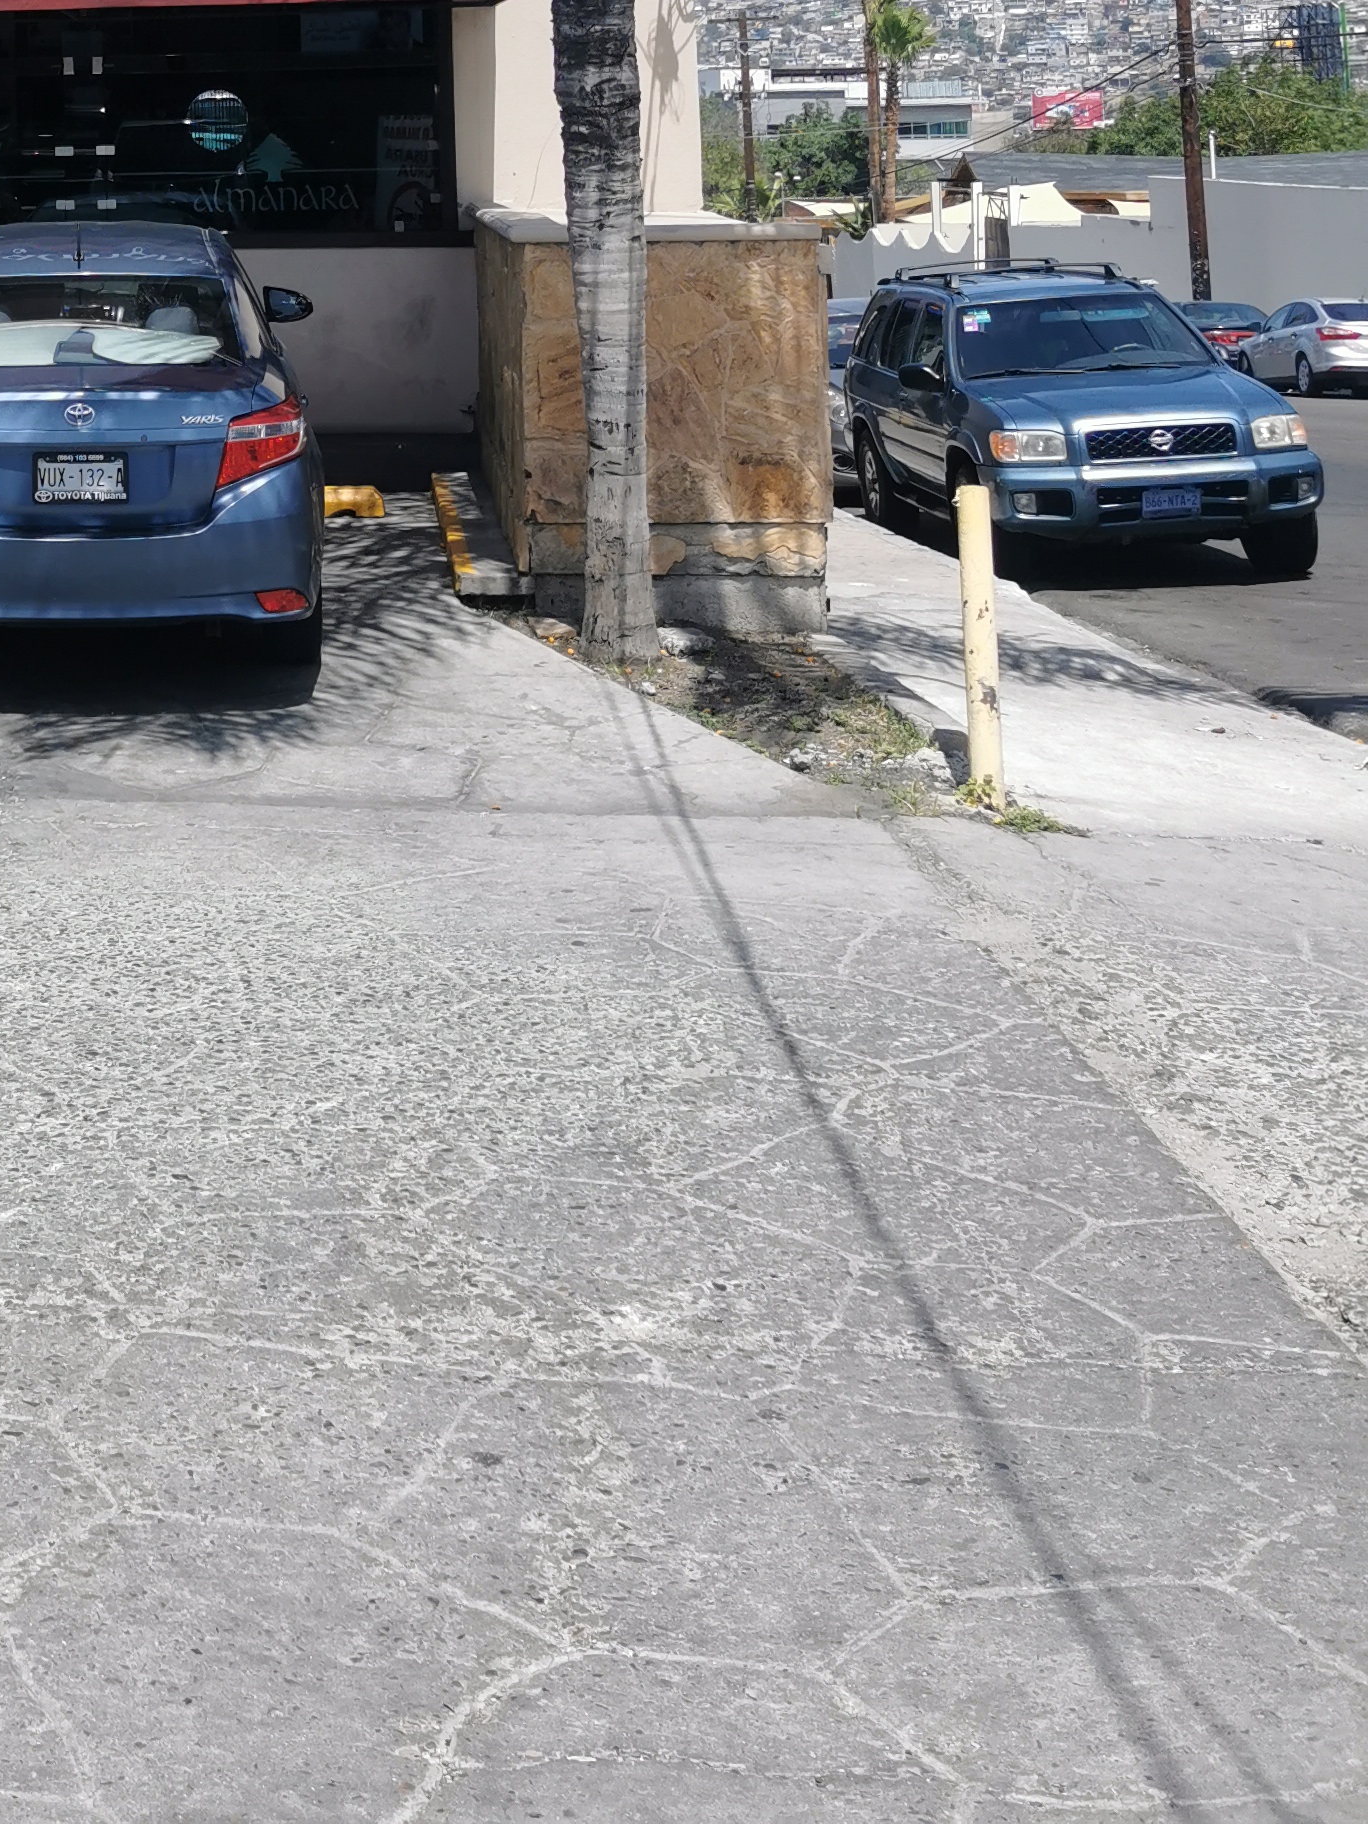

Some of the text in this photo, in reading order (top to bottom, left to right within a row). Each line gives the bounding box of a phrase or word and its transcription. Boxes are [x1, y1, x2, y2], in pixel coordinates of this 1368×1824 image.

[180, 414, 224, 425] YARIS
[38, 467, 124, 488] VUX-132-A
[53, 491, 92, 501] TOYOTA
